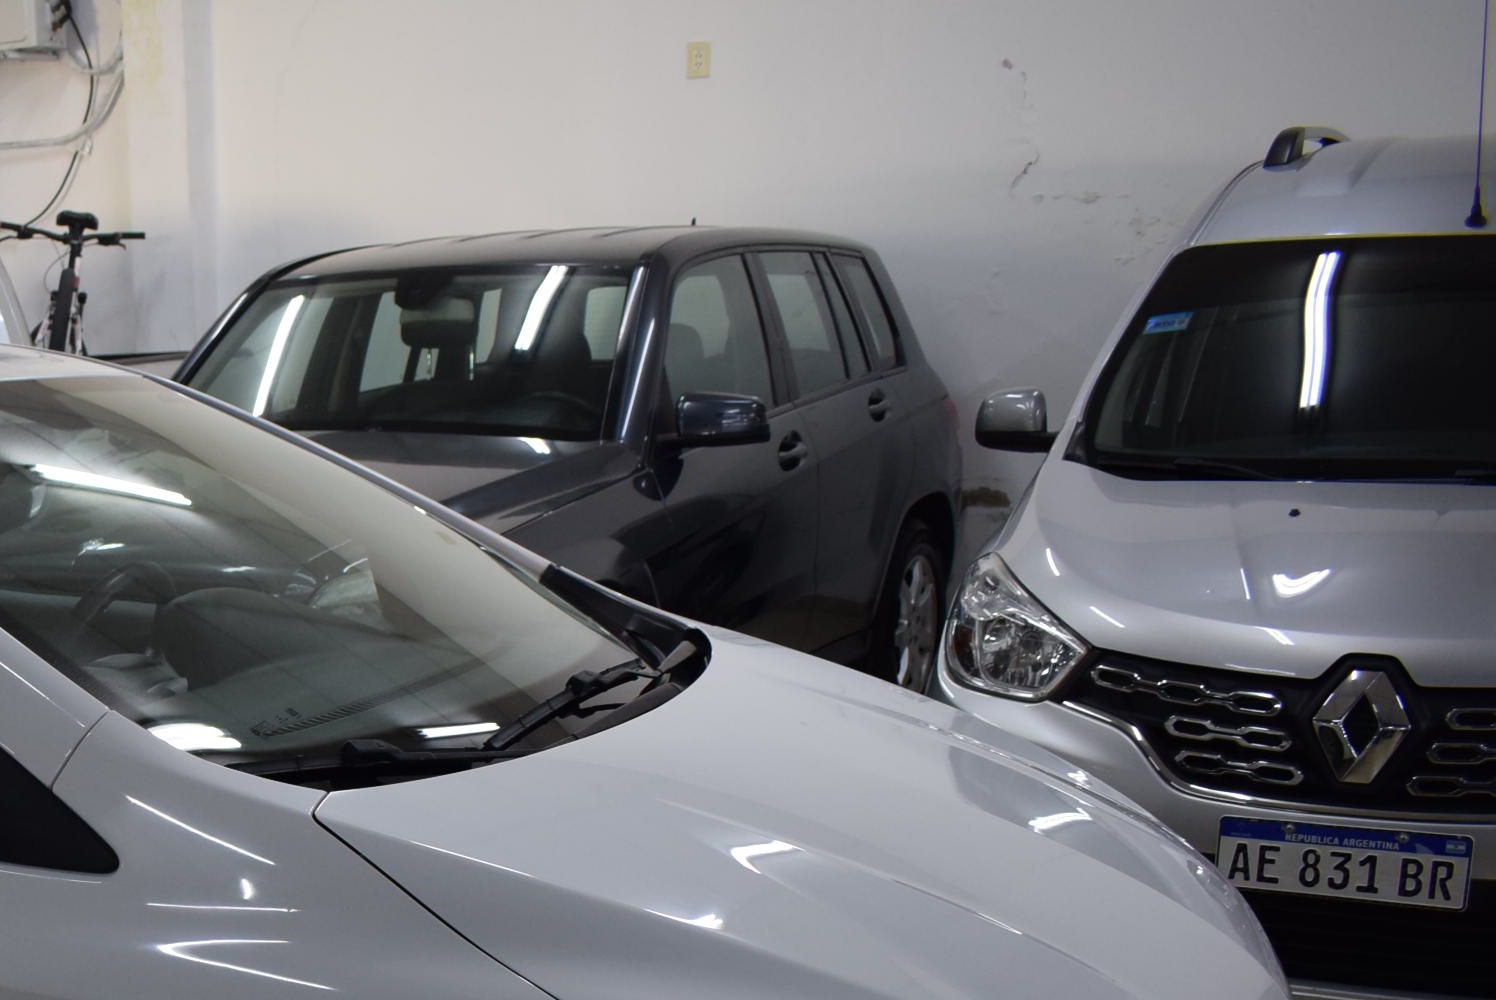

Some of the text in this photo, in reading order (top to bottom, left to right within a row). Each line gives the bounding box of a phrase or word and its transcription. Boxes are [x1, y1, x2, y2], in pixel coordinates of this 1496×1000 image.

[1342, 837, 1400, 851] ARGENTINA
[1228, 843, 1455, 901] AE 831 BR
